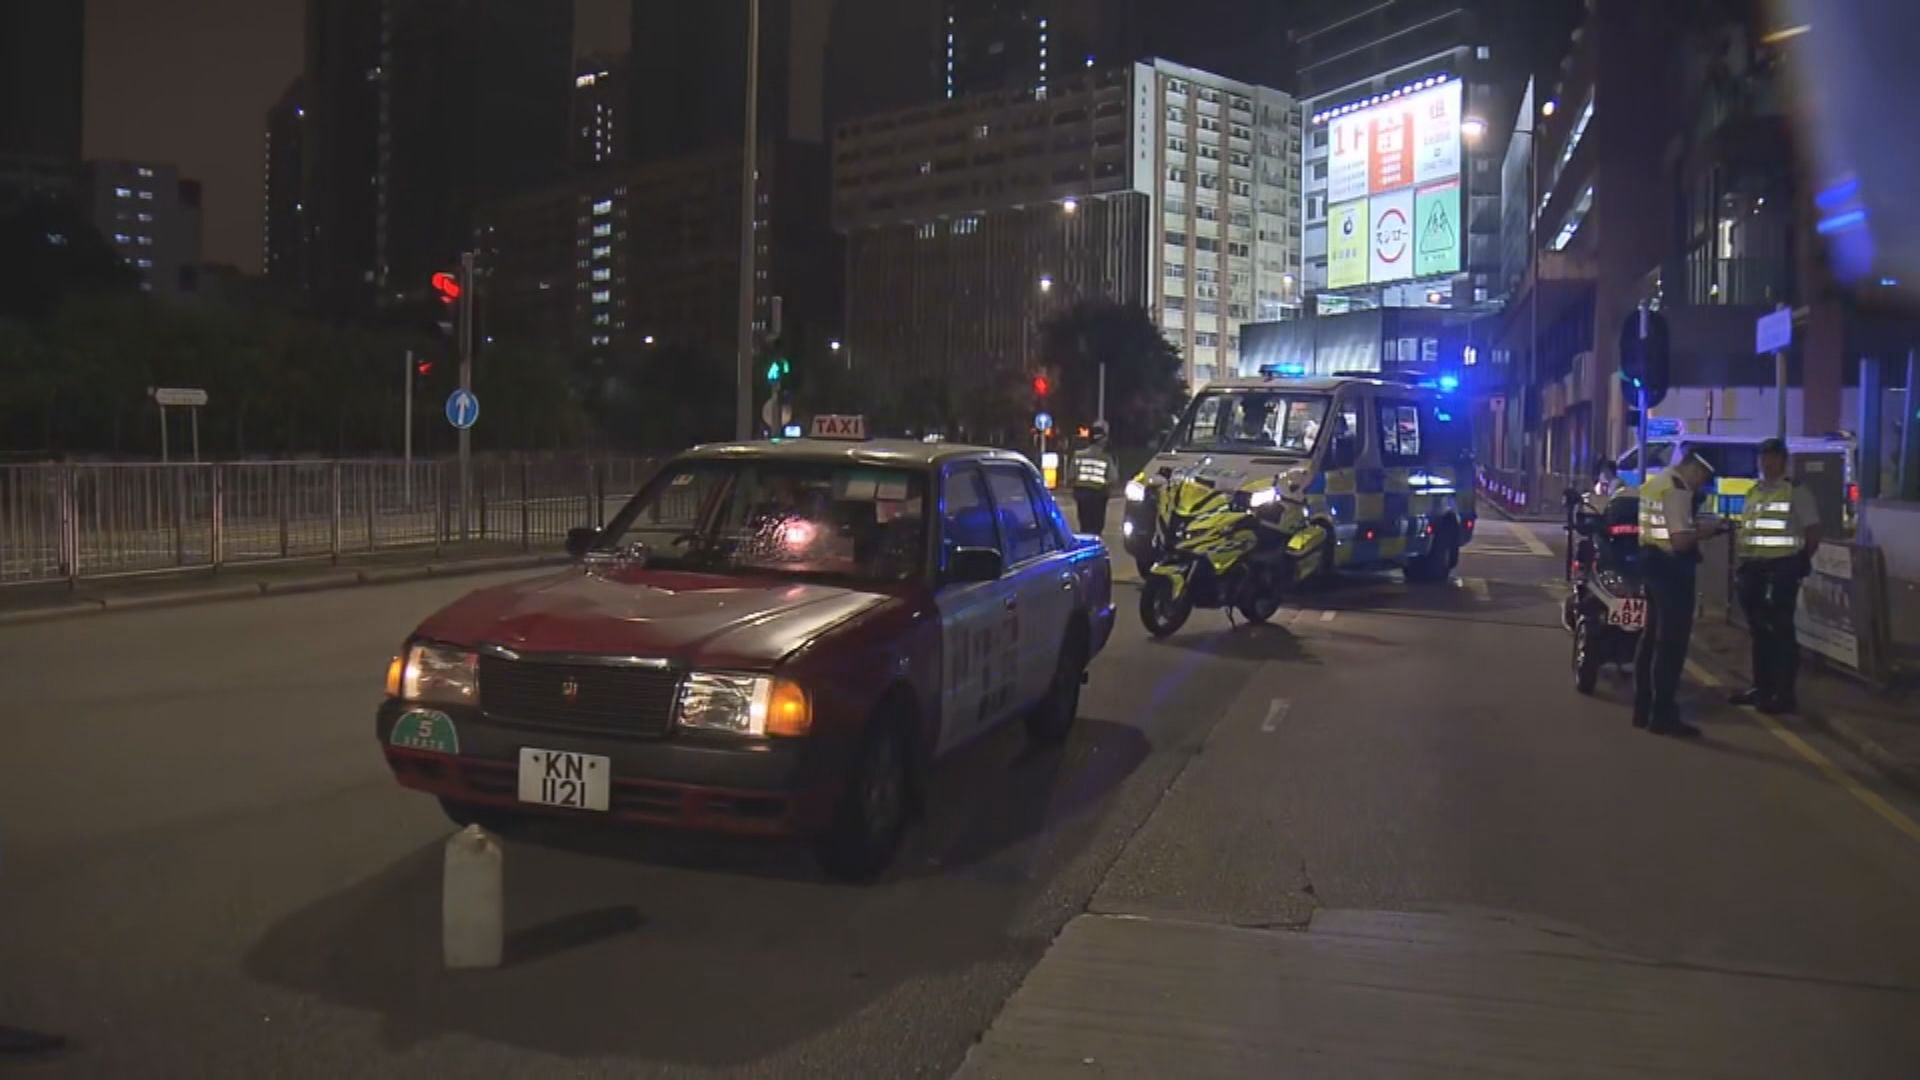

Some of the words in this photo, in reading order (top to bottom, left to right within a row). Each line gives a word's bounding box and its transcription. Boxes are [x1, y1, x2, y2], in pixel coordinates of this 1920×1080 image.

[816, 419, 859, 434] TAXI
[1623, 600, 1645, 613] AM
[1611, 611, 1643, 625] 684
[418, 720, 433, 737] 5
[545, 752, 583, 781] KN
[543, 778, 585, 808] 1121
